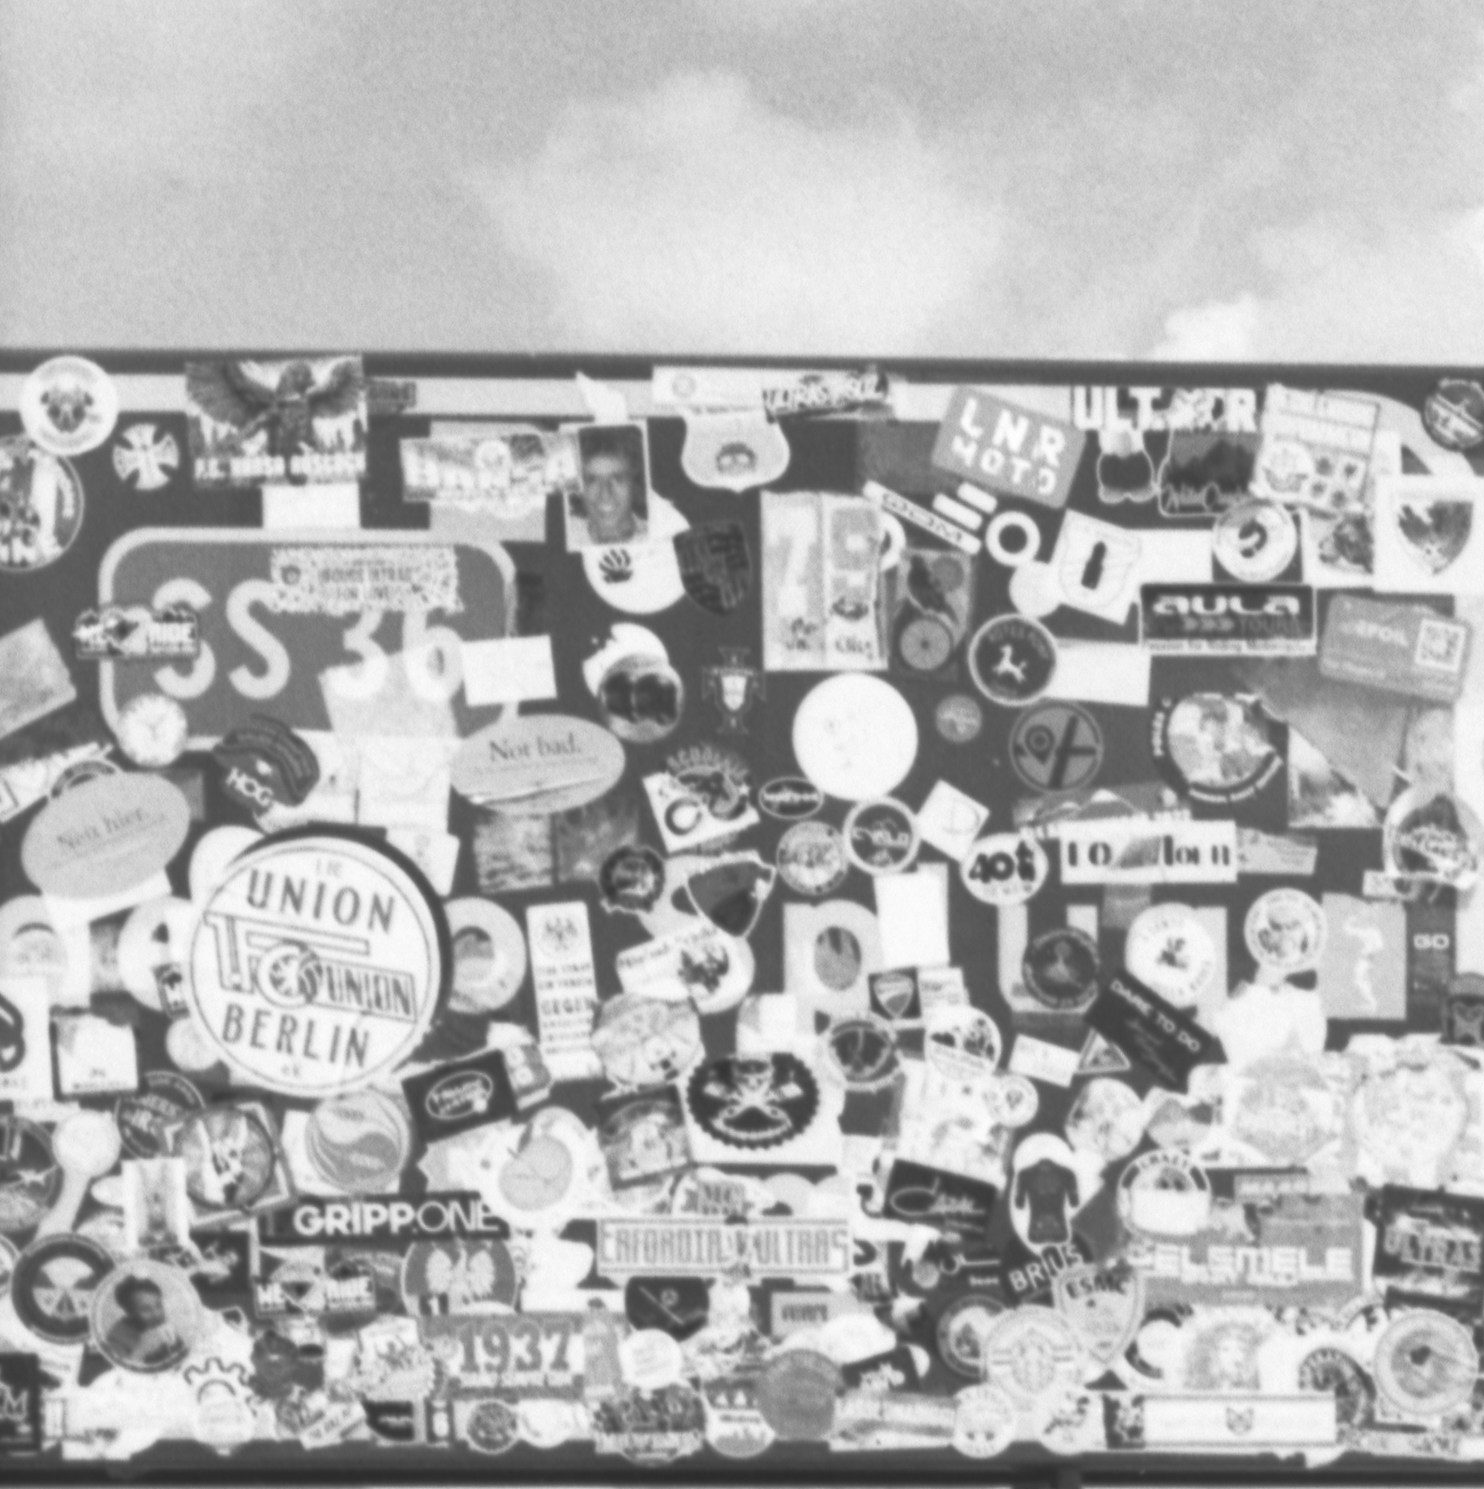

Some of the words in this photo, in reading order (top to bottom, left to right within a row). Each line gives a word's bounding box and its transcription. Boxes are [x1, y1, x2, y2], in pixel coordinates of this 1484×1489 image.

[960, 396, 1065, 466] LNR
[247, 868, 394, 935] UNION
[222, 1003, 370, 1068] BERLIN
[458, 1319, 573, 1374] 1937
